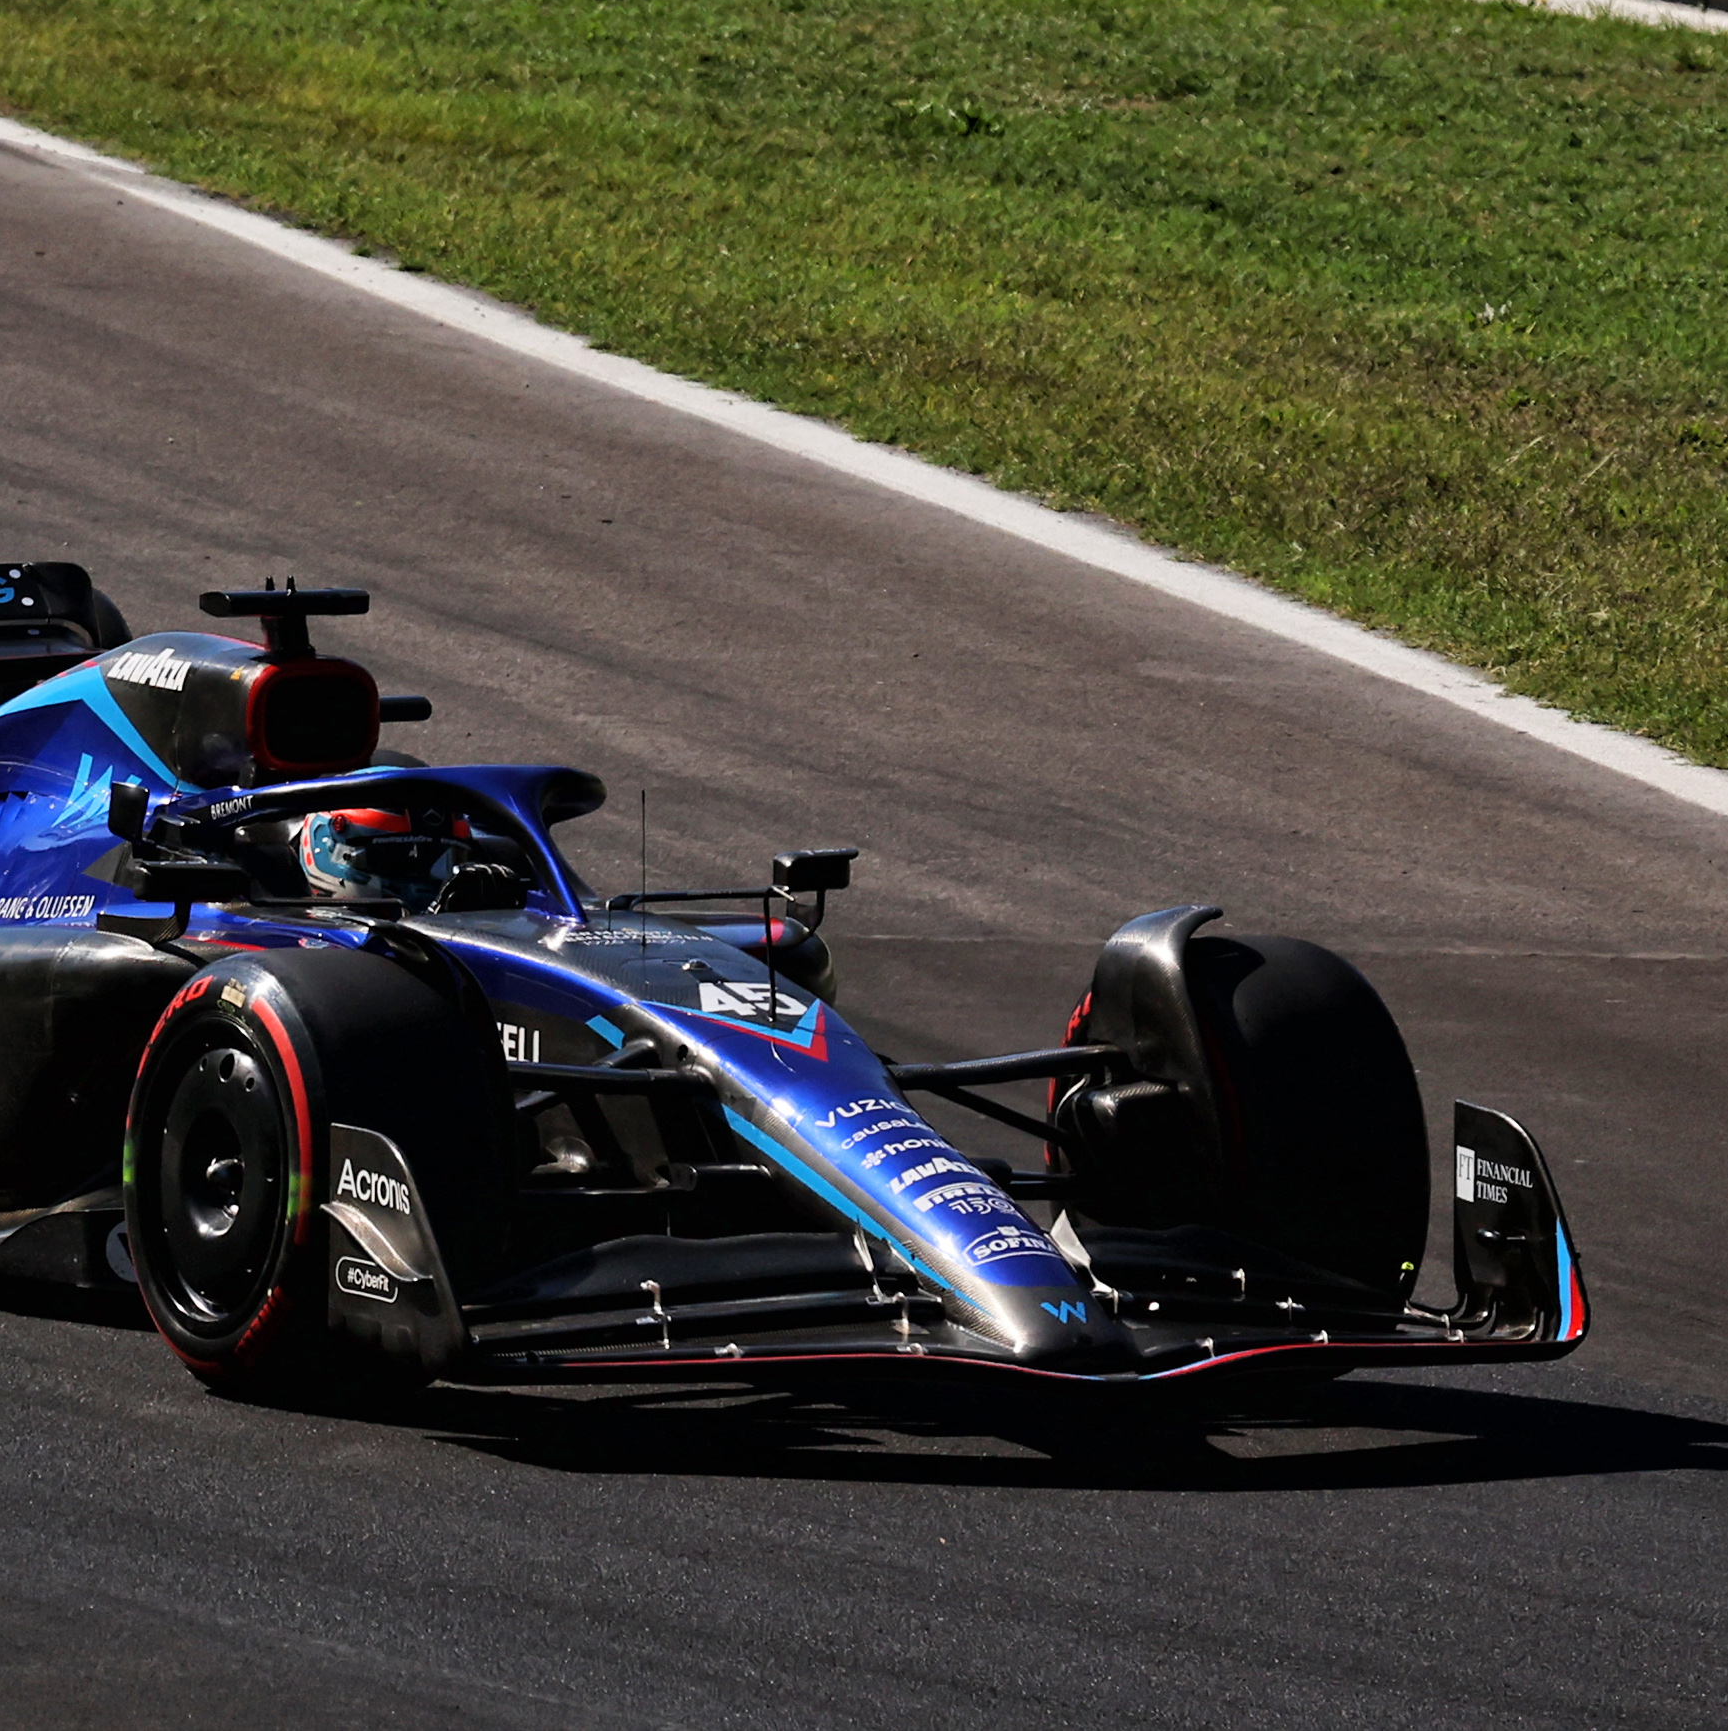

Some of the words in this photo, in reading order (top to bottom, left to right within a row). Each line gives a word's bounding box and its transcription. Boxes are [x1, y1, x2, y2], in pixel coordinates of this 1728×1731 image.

[107, 647, 192, 692] LAVAZZA
[210, 794, 254, 821] BREMONT
[35, 895, 95, 919] OLUFSEN
[697, 982, 809, 1018] 45
[1457, 1149, 1473, 1182] FT
[1476, 1156, 1533, 1189] FINANCIAL
[337, 1158, 411, 1216] Acronis
[1476, 1179, 1508, 1204] TIMES
[347, 1266, 389, 1293] #CyberFit
